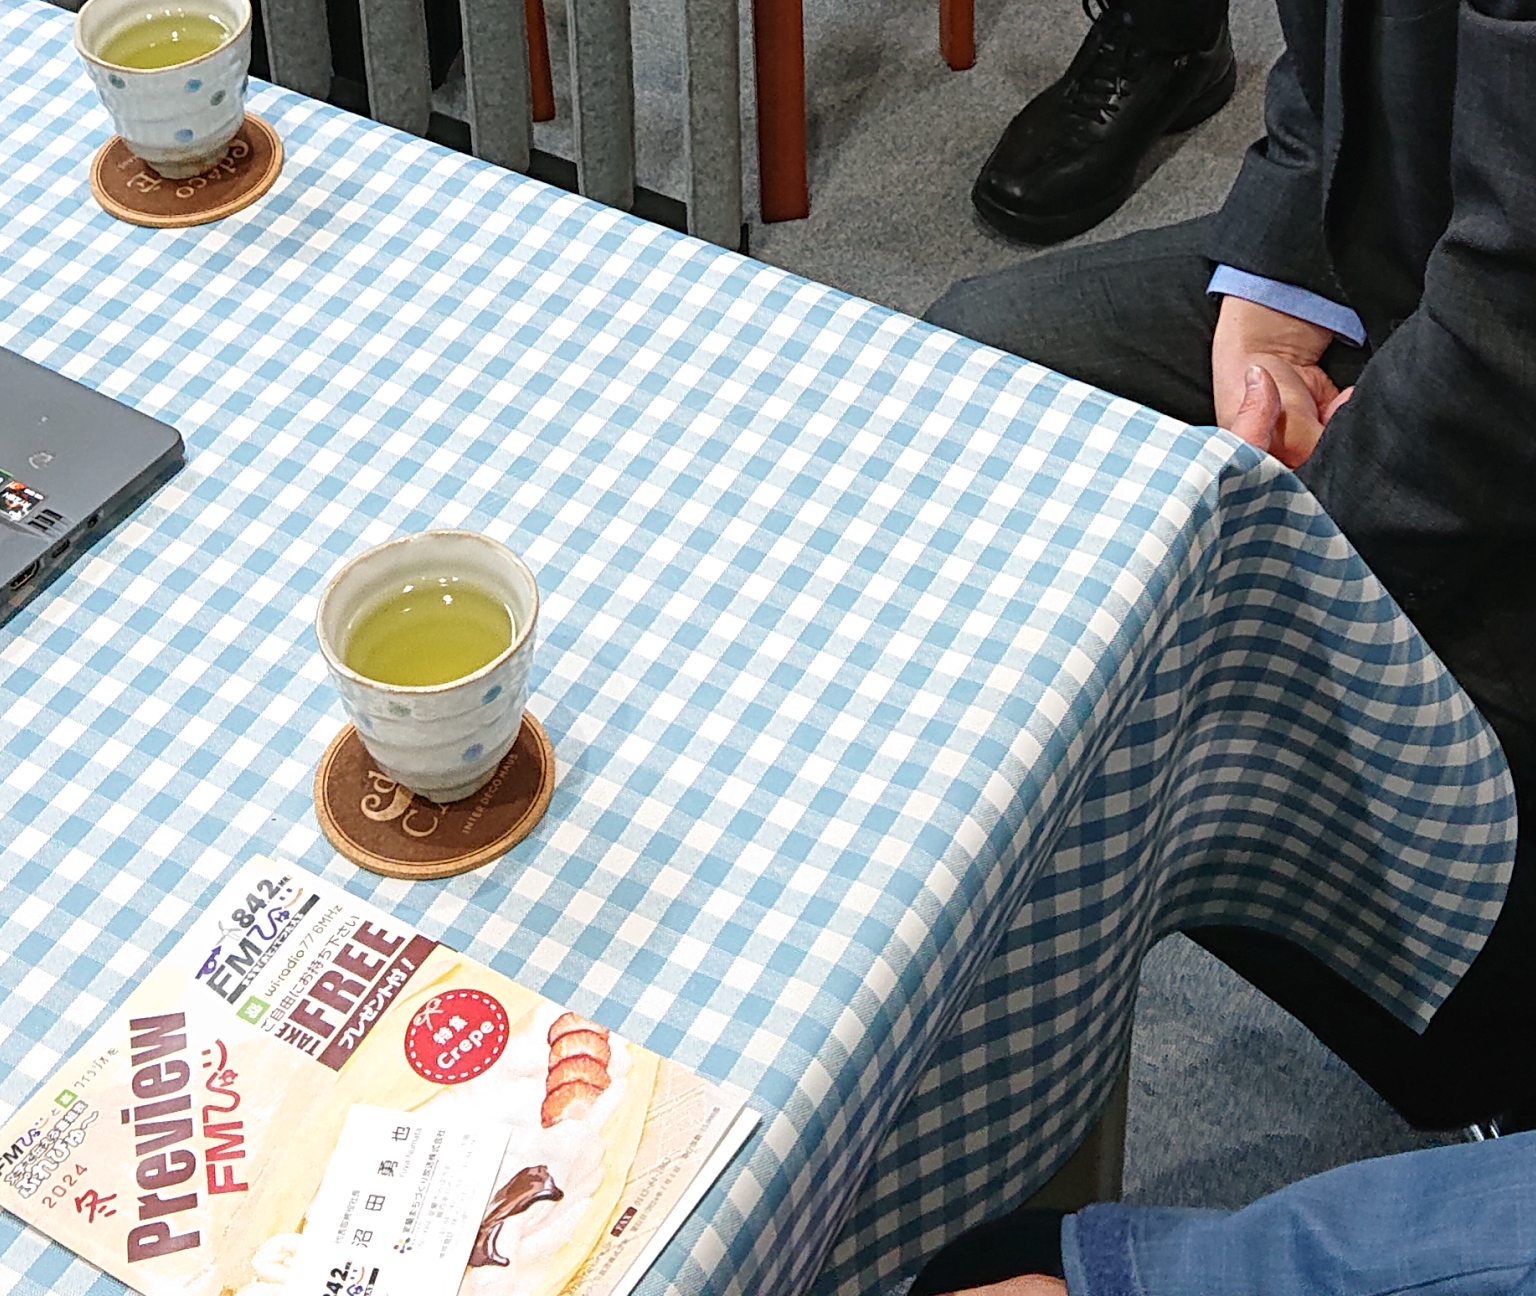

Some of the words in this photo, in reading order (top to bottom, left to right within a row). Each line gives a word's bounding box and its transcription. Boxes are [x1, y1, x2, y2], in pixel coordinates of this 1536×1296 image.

[261, 914, 361, 1033] ご自由にお持ち下さい
[287, 920, 407, 1040] FREE
[274, 1021, 322, 1056] TAKE
[436, 1020, 495, 1070] Crepe
[120, 1011, 202, 1265] Preview
[41, 1163, 88, 1210] 2024
[74, 1189, 117, 1224] 冬
